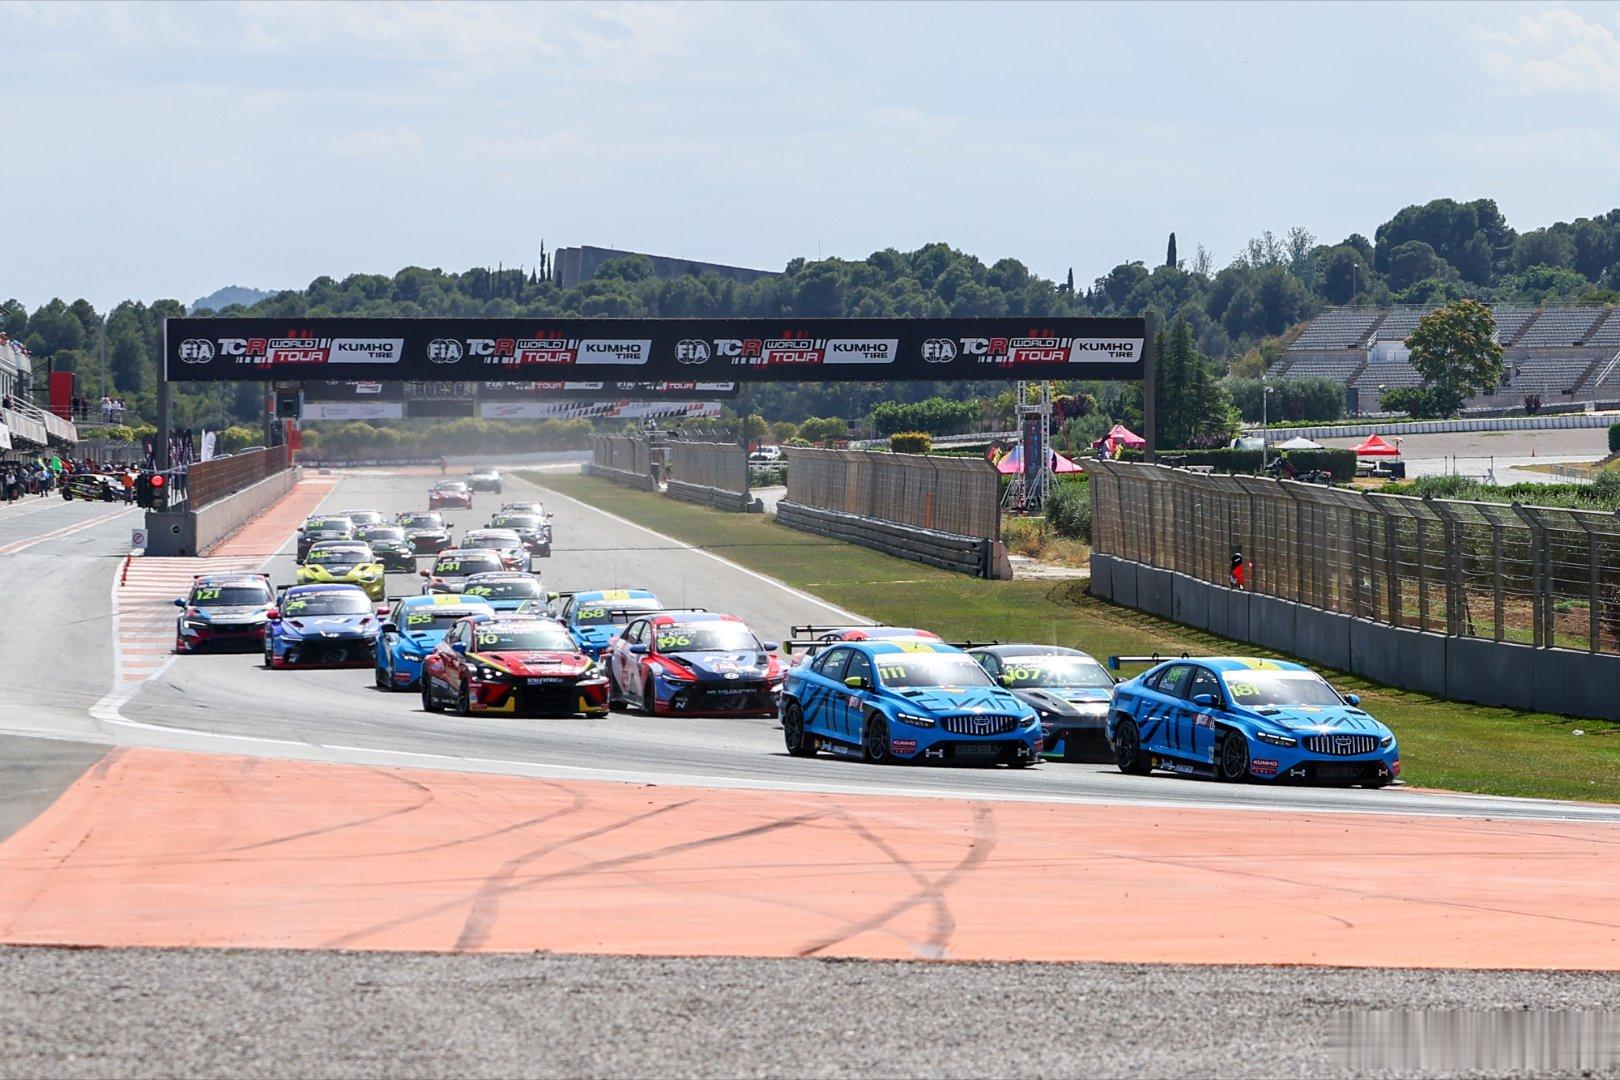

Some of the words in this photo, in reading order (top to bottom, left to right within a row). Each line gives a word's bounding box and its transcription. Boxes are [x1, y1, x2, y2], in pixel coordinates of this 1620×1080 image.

[181, 344, 213, 358] FIA
[218, 338, 267, 355] TCR
[338, 343, 393, 351] KUMHO
[429, 344, 460, 358] FIA
[466, 339, 514, 356] TCR
[586, 344, 641, 352] KUMHO
[677, 344, 708, 358] FIA
[713, 339, 762, 356] TCR
[833, 344, 888, 352] KUMHO
[924, 343, 954, 357] FIA
[960, 338, 1008, 355] TCR
[1079, 342, 1133, 351] KUMHO
[277, 351, 324, 361] TOUR
[525, 352, 571, 362] TOUR
[772, 352, 818, 362] TOUR
[1019, 351, 1064, 361] TOUR
[196, 590, 220, 600] 121
[407, 614, 432, 624] 155
[577, 608, 605, 620] 168
[478, 634, 498, 644] 10
[657, 636, 690, 648] 196
[878, 666, 906, 680] 111
[1229, 684, 1260, 696] 181
